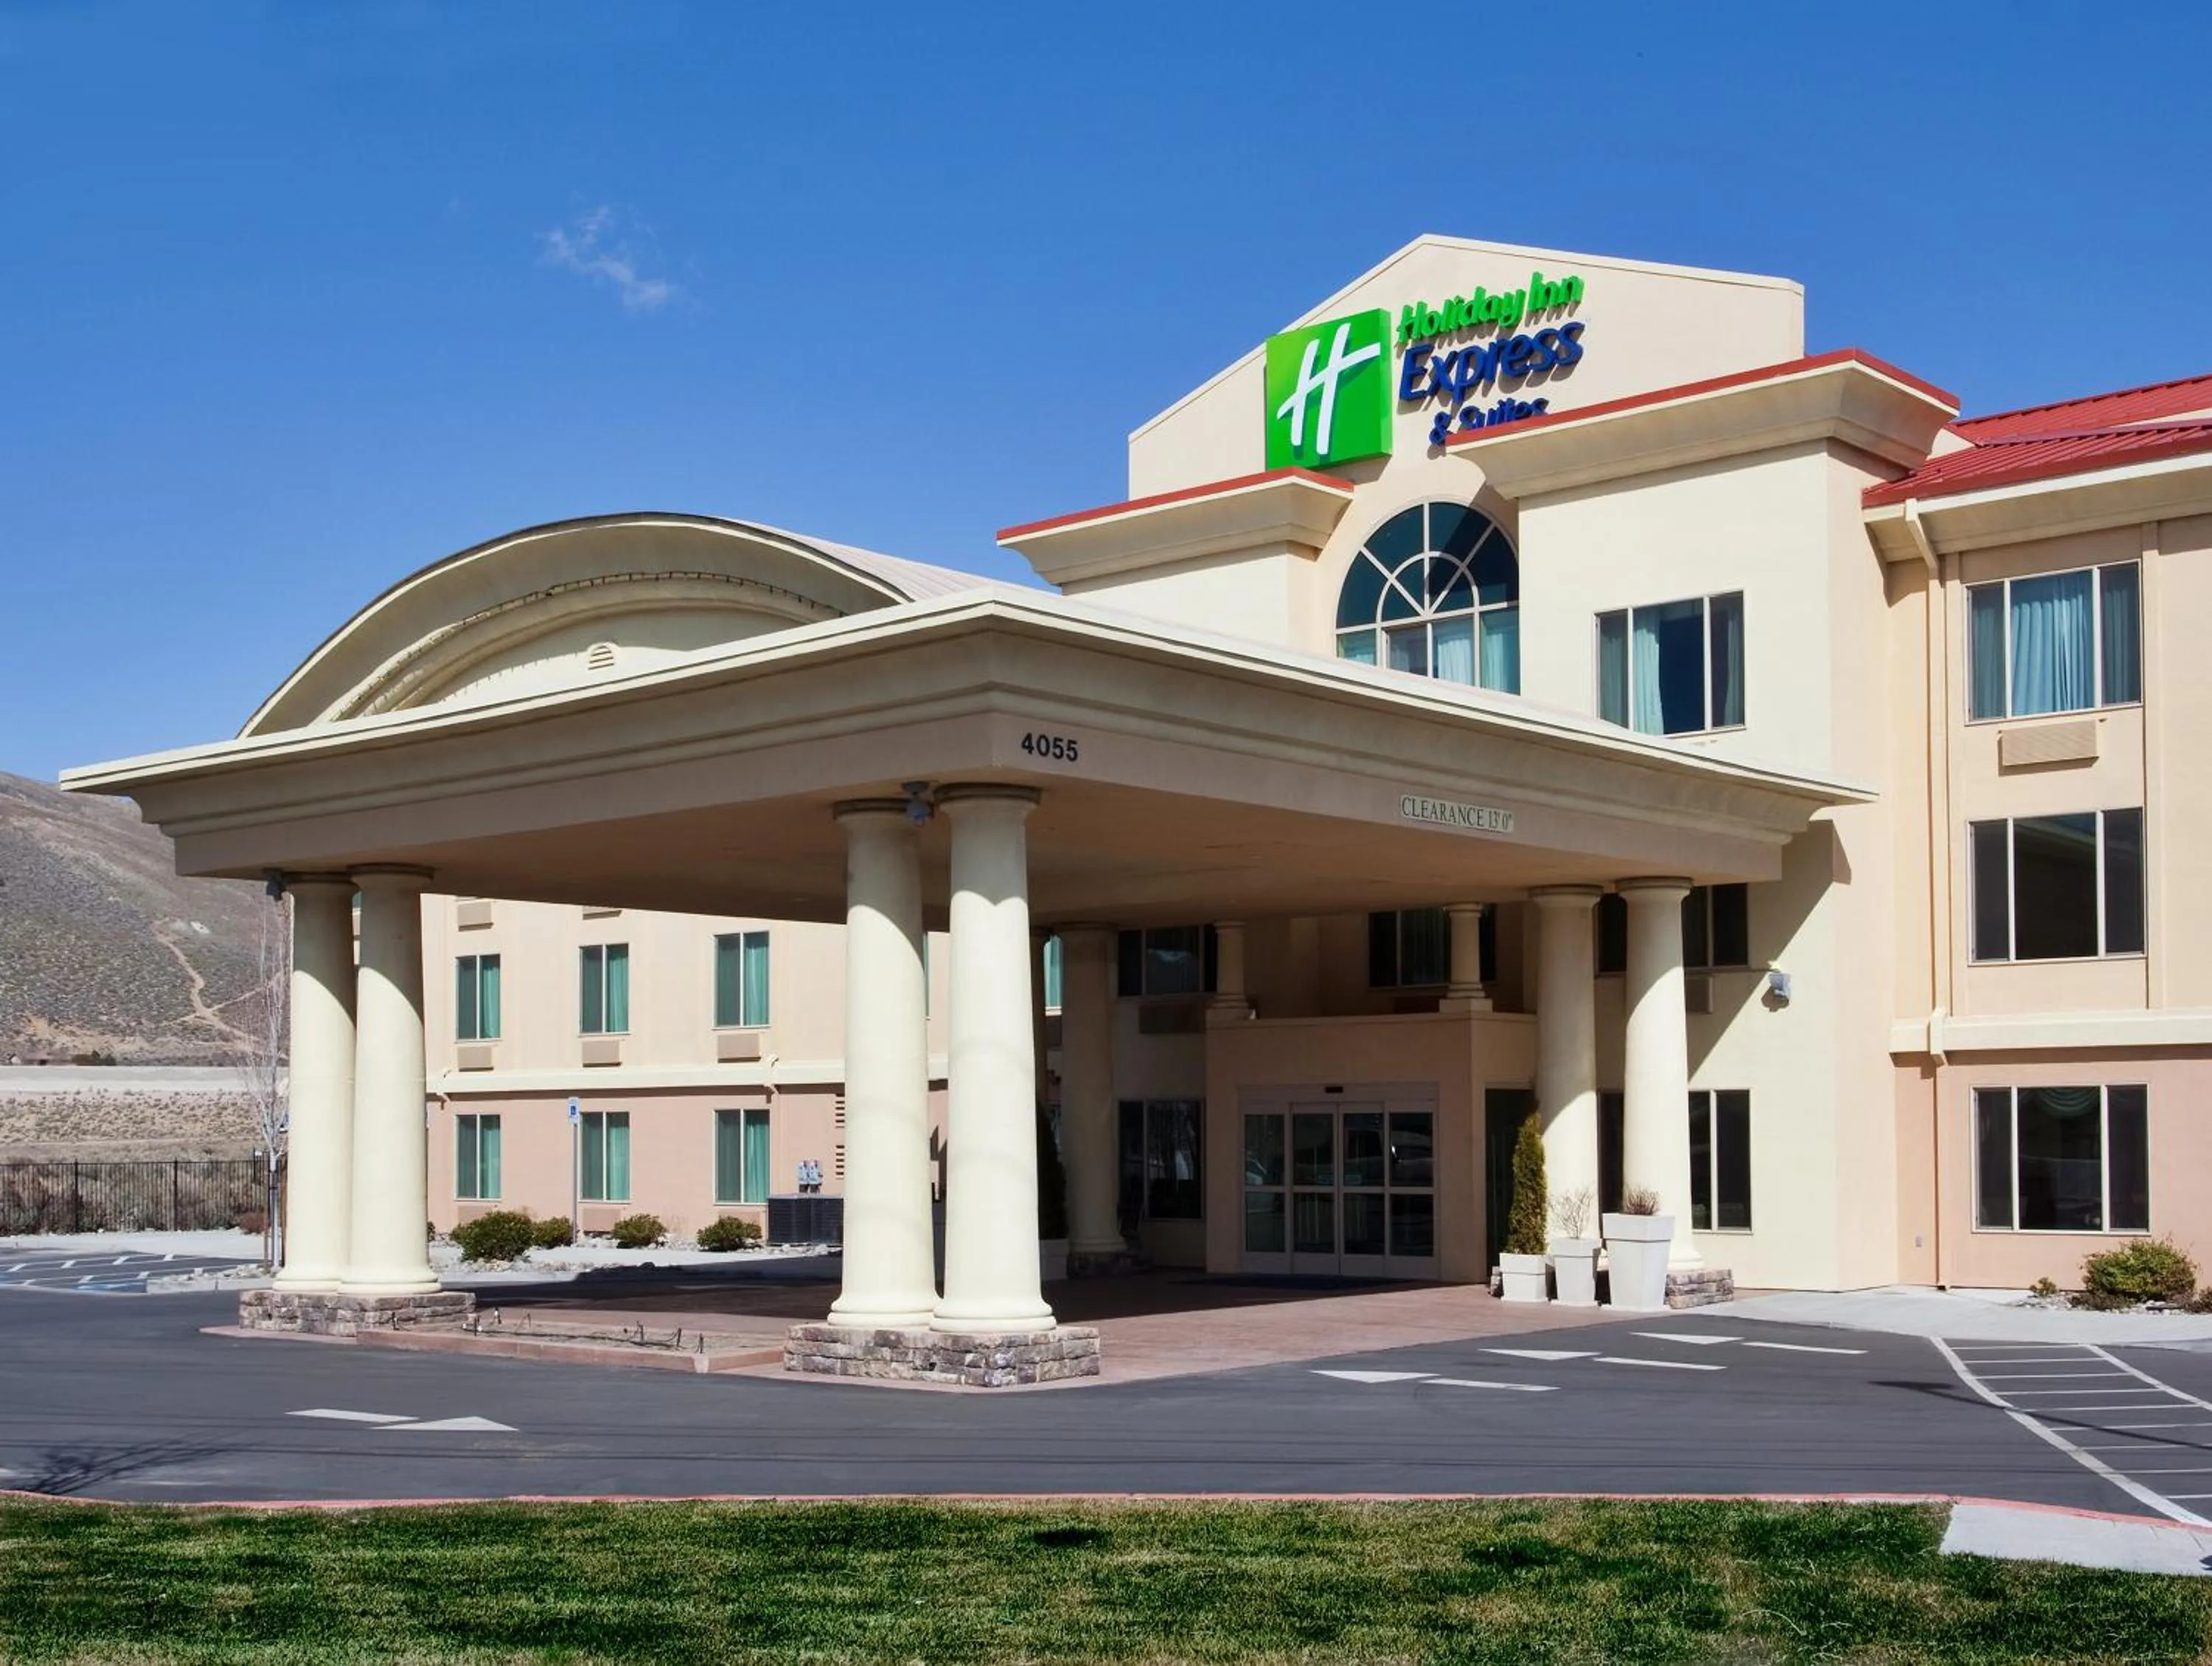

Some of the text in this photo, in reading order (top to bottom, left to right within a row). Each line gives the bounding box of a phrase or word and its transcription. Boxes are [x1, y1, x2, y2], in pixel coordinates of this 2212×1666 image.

[1396, 271, 1585, 344] Holiday Inn
[1399, 321, 1585, 402] Express
[1428, 411, 1453, 446] &
[1021, 732, 1078, 762] 4055
[1402, 796, 1484, 827] CLEARANCE
